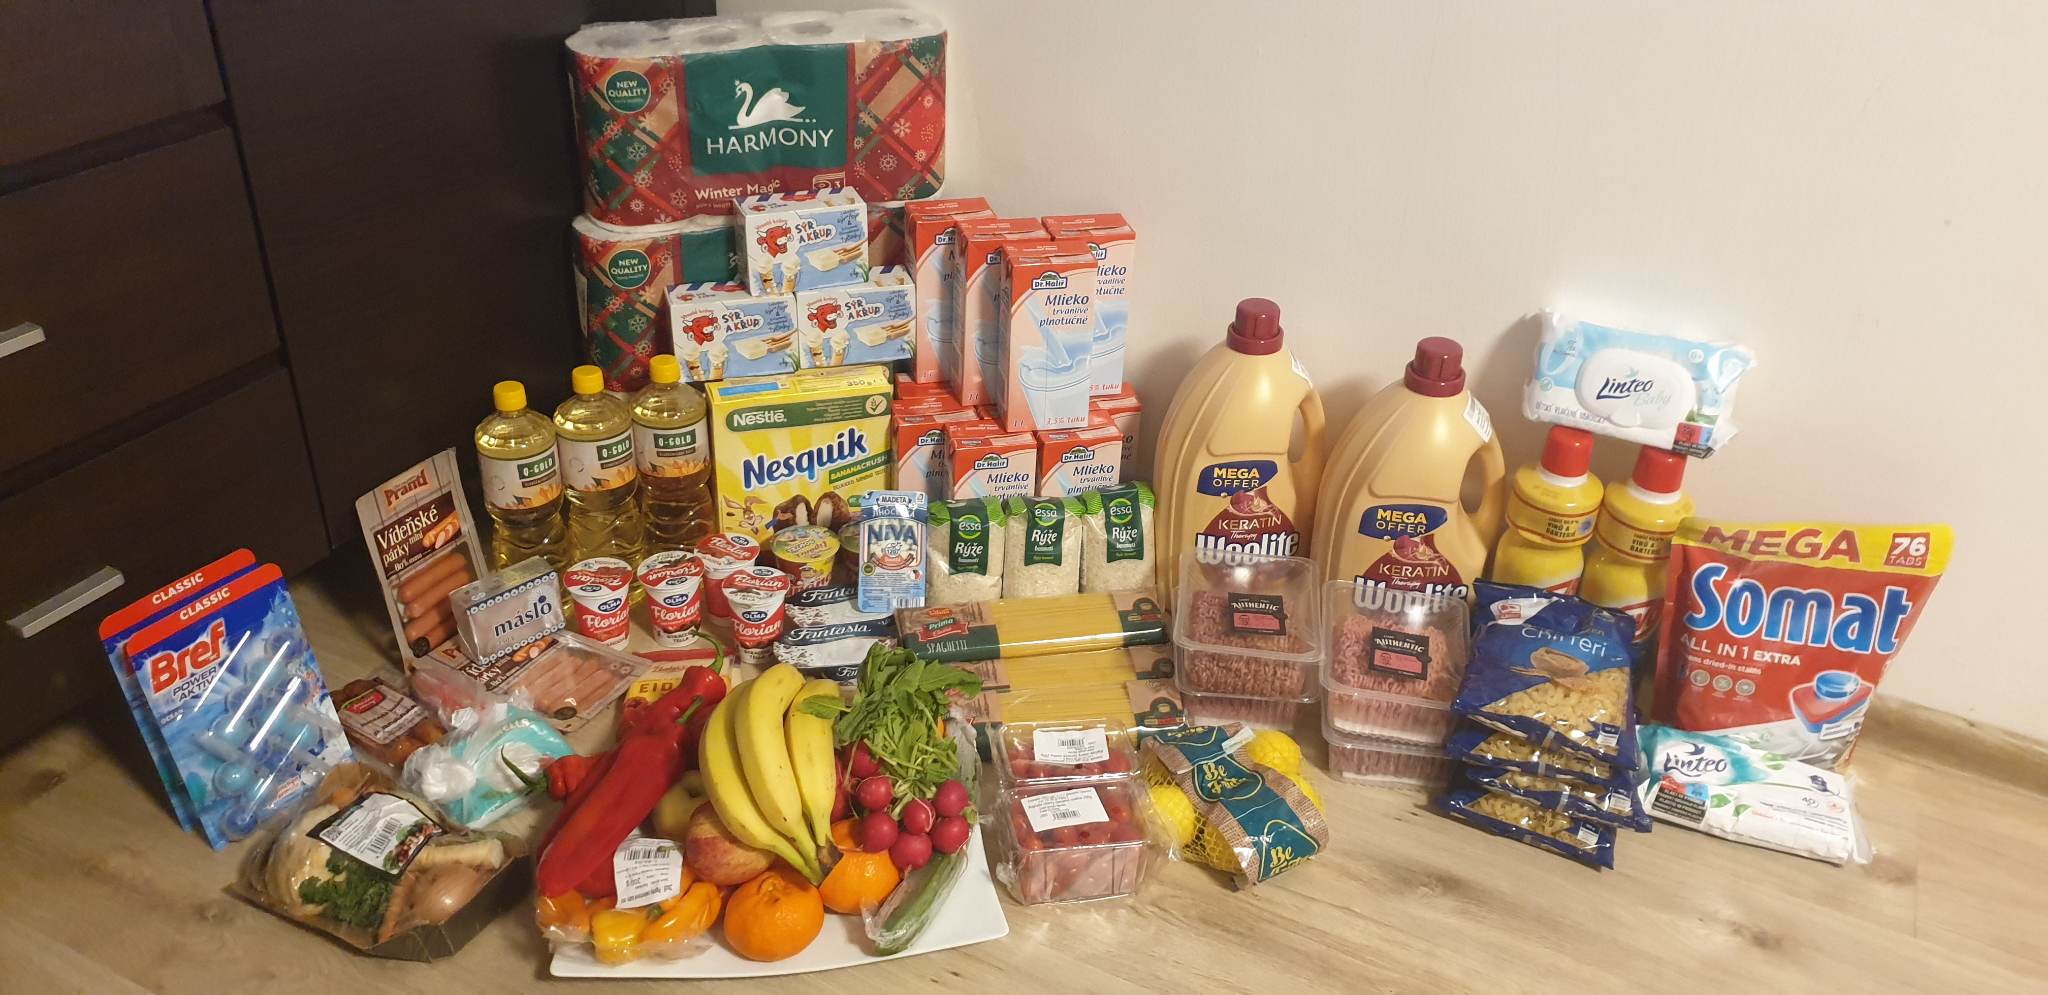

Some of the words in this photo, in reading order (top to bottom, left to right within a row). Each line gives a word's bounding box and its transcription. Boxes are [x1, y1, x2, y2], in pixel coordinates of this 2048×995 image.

[616, 80, 637, 88] NEW
[608, 88, 648, 97] QUALITY
[706, 128, 834, 155] HARMONY
[695, 186, 742, 201] Winter
[747, 178, 780, 196] Magic
[611, 265, 649, 275] QUALITY
[618, 258, 639, 266] NEW
[1097, 265, 1126, 276] lieko
[1098, 276, 1126, 285] vanlivé
[1096, 285, 1125, 295] tučné
[1045, 294, 1089, 306] Mlieko
[1053, 306, 1088, 315] trvanlivé
[1039, 316, 1088, 327] plnotučné
[1596, 376, 1655, 400] Linteo
[742, 427, 868, 489] Nesquik
[987, 472, 1029, 484] Mlieko
[1073, 464, 1114, 476] Mlieko
[1213, 467, 1260, 479] MEGA
[1212, 478, 1260, 488] OFFER
[1035, 508, 1057, 517] essa
[1109, 506, 1132, 516] essa
[1377, 509, 1428, 524] MEGA
[376, 504, 439, 550] Vídeňské
[958, 521, 981, 531] essa
[1218, 514, 1282, 530] KERATIN
[1376, 521, 1427, 534] OFFER
[868, 524, 918, 545] NIVA
[1031, 529, 1058, 546] Rýže
[1112, 527, 1138, 542] Rýže
[710, 537, 752, 558] Florian
[955, 542, 984, 557] Rýže
[1195, 531, 1300, 566] Woolite
[1703, 526, 1861, 563] MEGA
[1890, 537, 1927, 558] 76
[382, 543, 410, 568] párky
[1379, 563, 1449, 578] KERATIN
[152, 572, 204, 605] CLASSIC
[734, 575, 784, 588] Florian
[665, 595, 688, 605] OLMA
[801, 586, 857, 602] Fanta
[1354, 575, 1469, 615] Woolite
[179, 587, 231, 620] CLASSIC
[599, 599, 621, 610] OLMA
[651, 600, 700, 621] Florian
[1231, 601, 1280, 612] AUTHENTIC
[1683, 562, 1913, 655] Somat
[494, 600, 552, 637] máslo
[582, 610, 629, 628] Floria
[734, 620, 783, 636] Florian
[788, 622, 871, 641] Fantasia
[926, 640, 968, 654] SPAGHETTI
[1374, 638, 1425, 653] AUTHENTIC
[1680, 633, 1711, 653] ALL
[1717, 642, 1738, 658] IN
[1742, 646, 1749, 660] 1
[1753, 650, 1801, 666] EXTRA
[151, 620, 225, 694] Bref
[173, 666, 217, 697] POWER
[179, 676, 215, 702] AKTIV
[1203, 762, 1228, 781] Be
[1664, 751, 1728, 777] Linteo
[1270, 846, 1295, 868] Be
